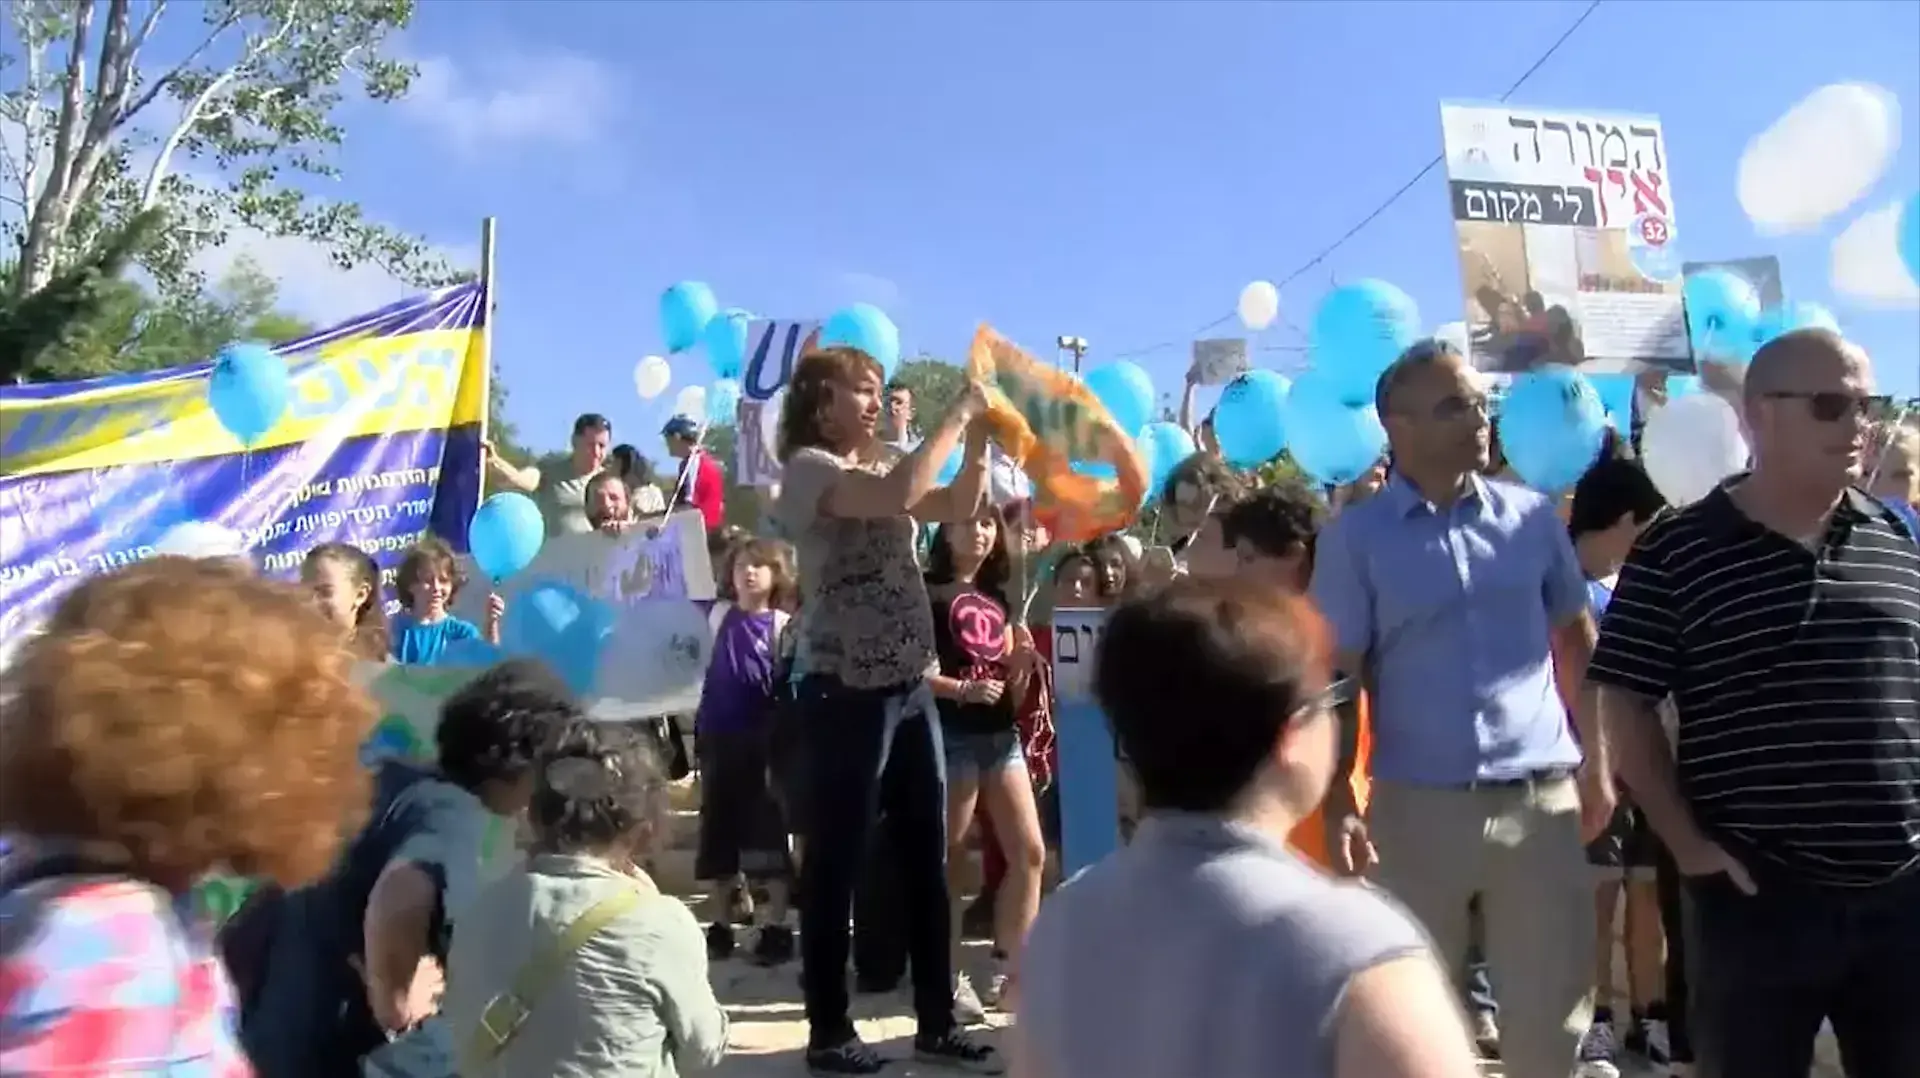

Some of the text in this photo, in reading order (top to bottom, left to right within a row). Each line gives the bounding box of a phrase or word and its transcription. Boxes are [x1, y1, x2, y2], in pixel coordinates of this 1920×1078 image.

[1508, 115, 1662, 170] המורה
[1464, 166, 1667, 227] אין לי מקום
[1644, 220, 1667, 241] 32
[295, 503, 391, 533] העדיפויות
[1056, 623, 1104, 664] ים
